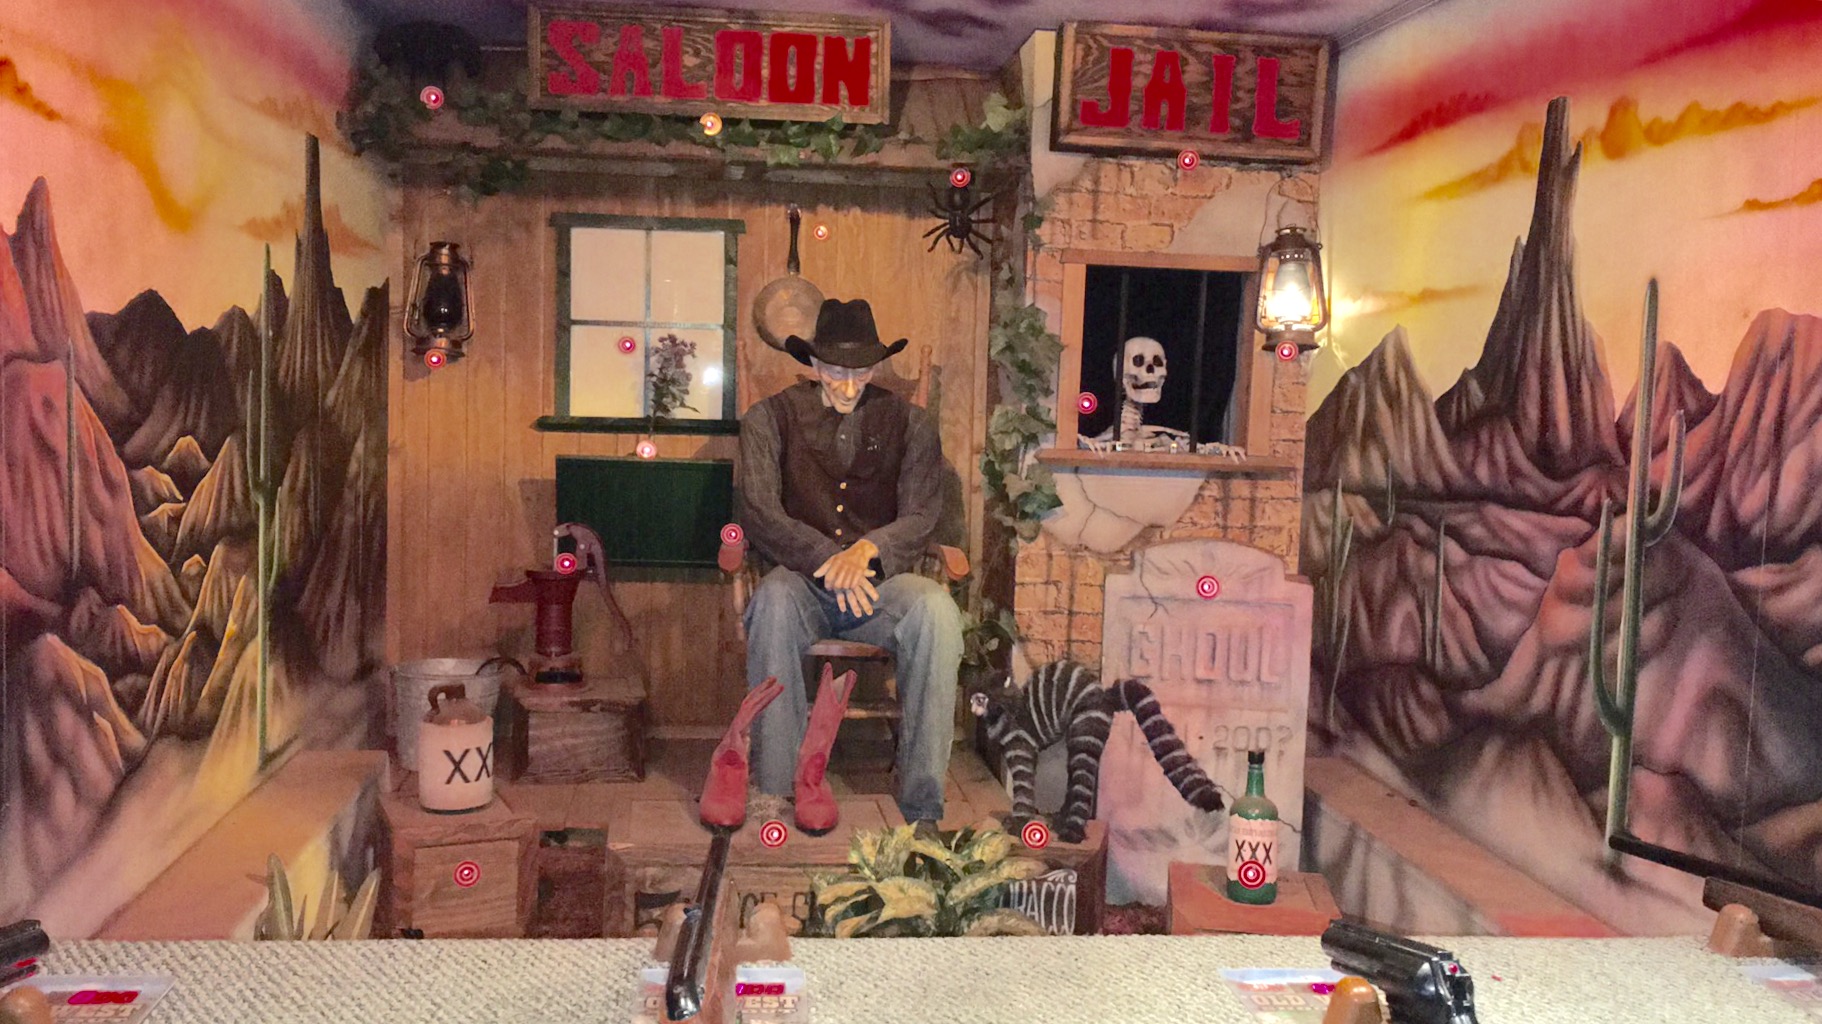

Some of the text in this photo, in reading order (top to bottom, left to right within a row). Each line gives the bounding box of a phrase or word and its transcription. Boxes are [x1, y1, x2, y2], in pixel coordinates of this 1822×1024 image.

[547, 20, 871, 107] SALOON
[1079, 47, 1302, 139] JAIL
[1235, 839, 1273, 865] XXX
